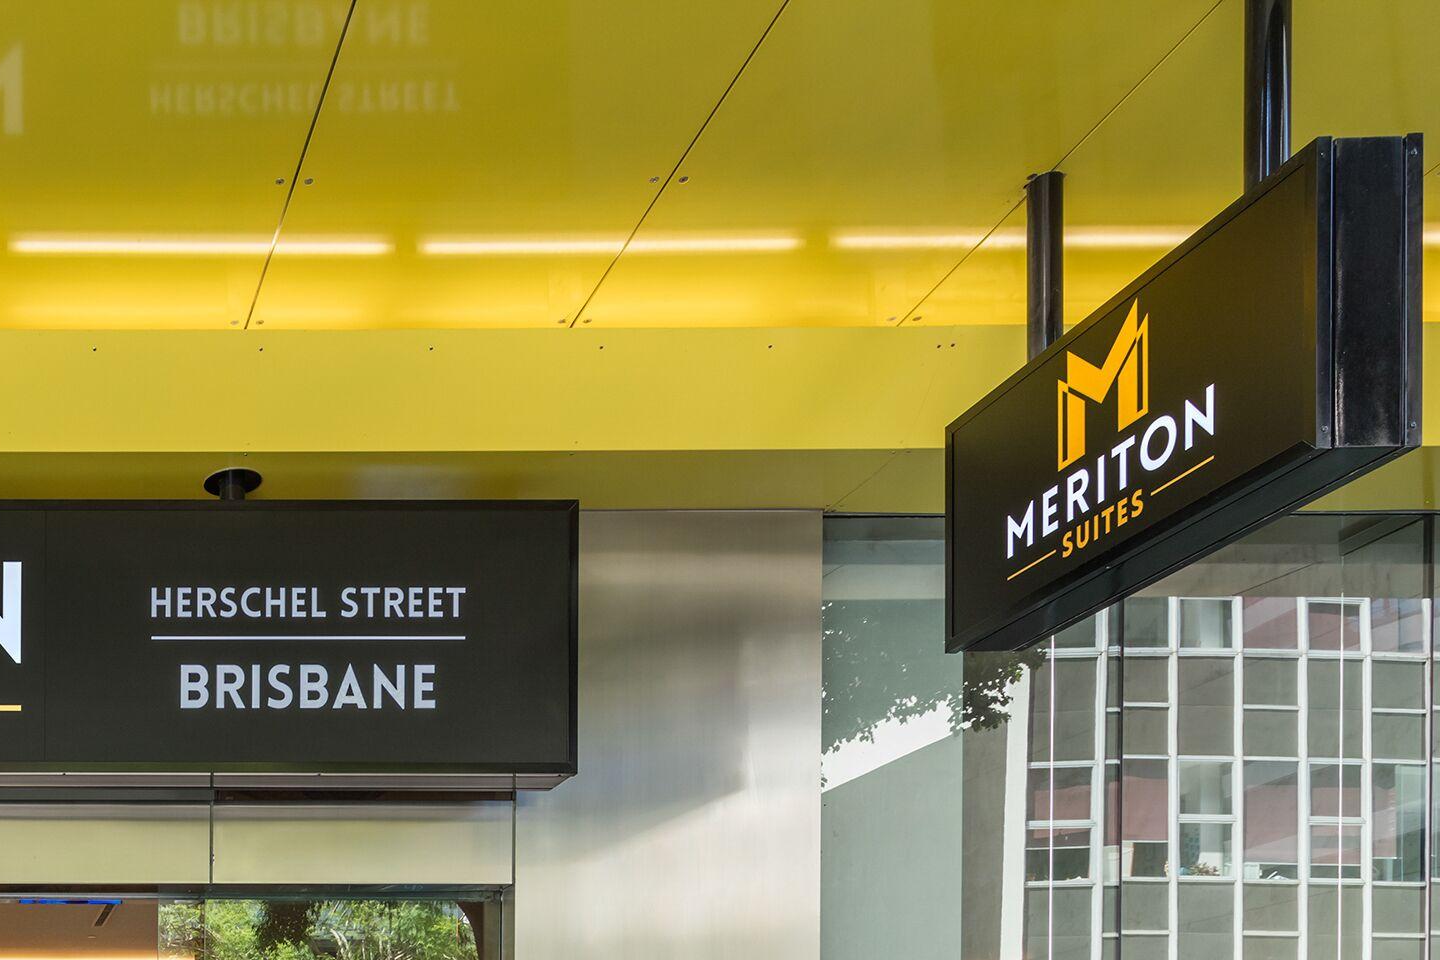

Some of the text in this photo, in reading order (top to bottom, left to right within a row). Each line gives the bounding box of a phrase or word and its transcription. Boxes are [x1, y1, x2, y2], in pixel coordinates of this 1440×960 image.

[1006, 382, 1215, 560] MERITON
[1062, 488, 1144, 558] SUITES
[151, 587, 466, 618] HERSCHEL STREET
[180, 663, 436, 710] BRISBANE
